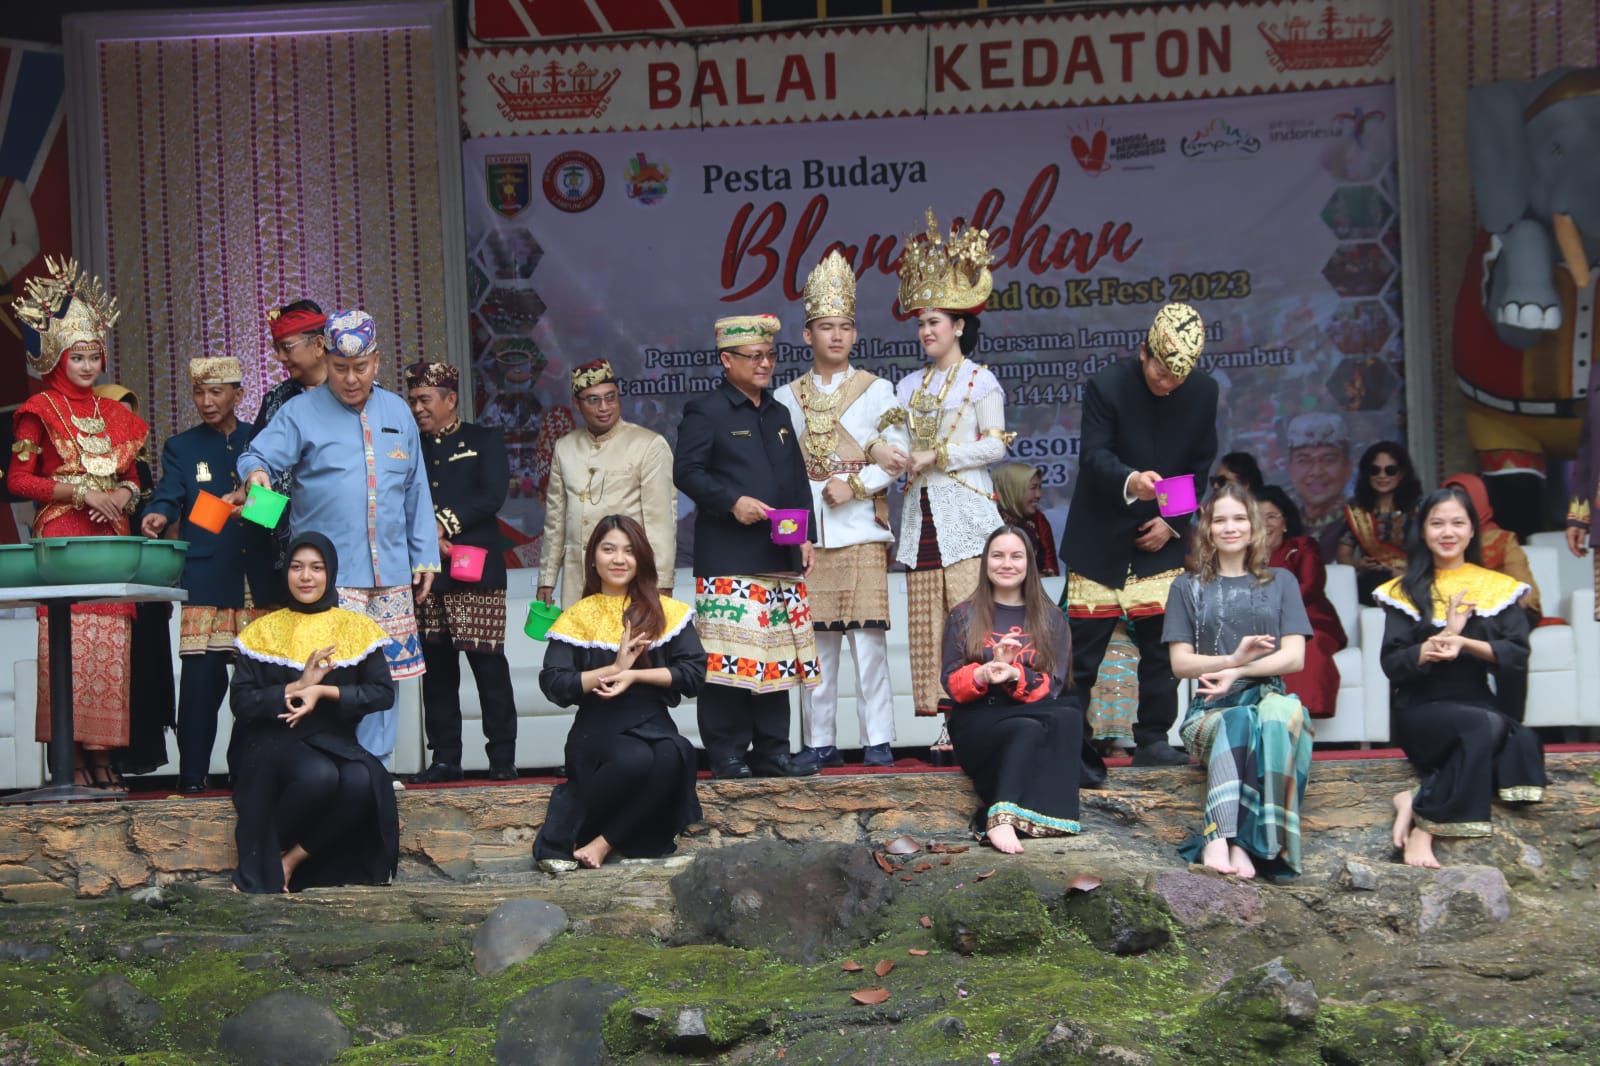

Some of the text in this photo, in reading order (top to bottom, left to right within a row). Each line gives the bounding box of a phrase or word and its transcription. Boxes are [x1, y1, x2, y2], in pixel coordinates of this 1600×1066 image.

[647, 23, 1232, 110] BALAI KEDATON
[702, 163, 792, 194] Pesta
[802, 155, 928, 194] Budaya
[985, 270, 1252, 311] ad to K-Fest 2023
[775, 339, 868, 362] Prosi
[978, 332, 1074, 353] bersama
[631, 372, 685, 396] andil
[986, 360, 1078, 383] ampung
[1014, 383, 1071, 405] 1444
